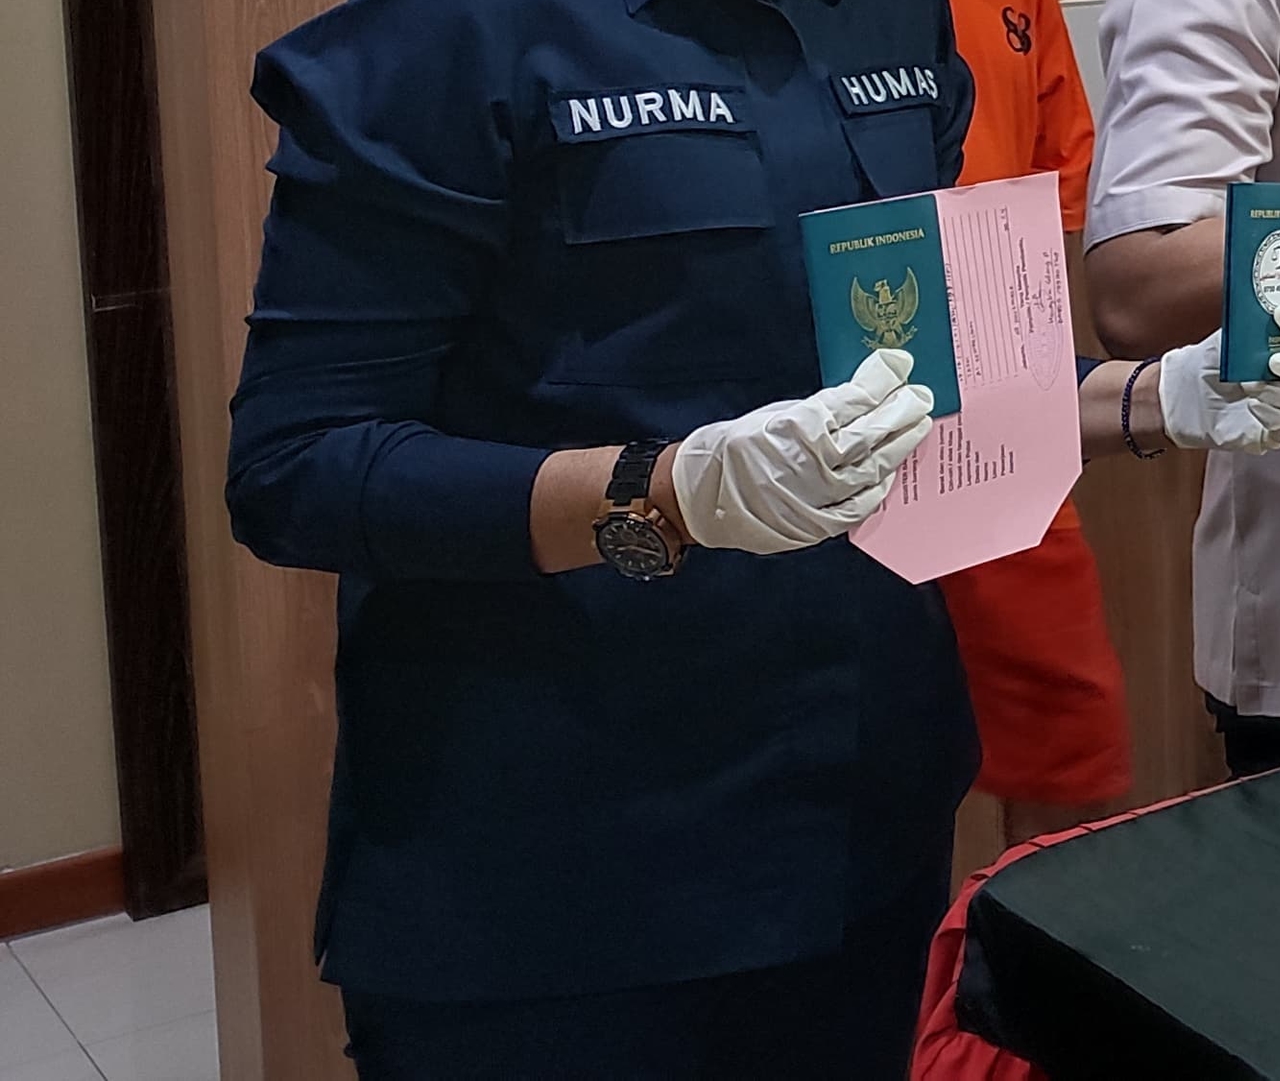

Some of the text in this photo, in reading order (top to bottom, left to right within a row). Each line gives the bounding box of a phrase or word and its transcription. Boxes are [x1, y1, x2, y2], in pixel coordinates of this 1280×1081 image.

[842, 66, 937, 106] HUMAS
[568, 88, 734, 135] NURMA
[830, 228, 925, 254] REPUBLIK INDONESIA
